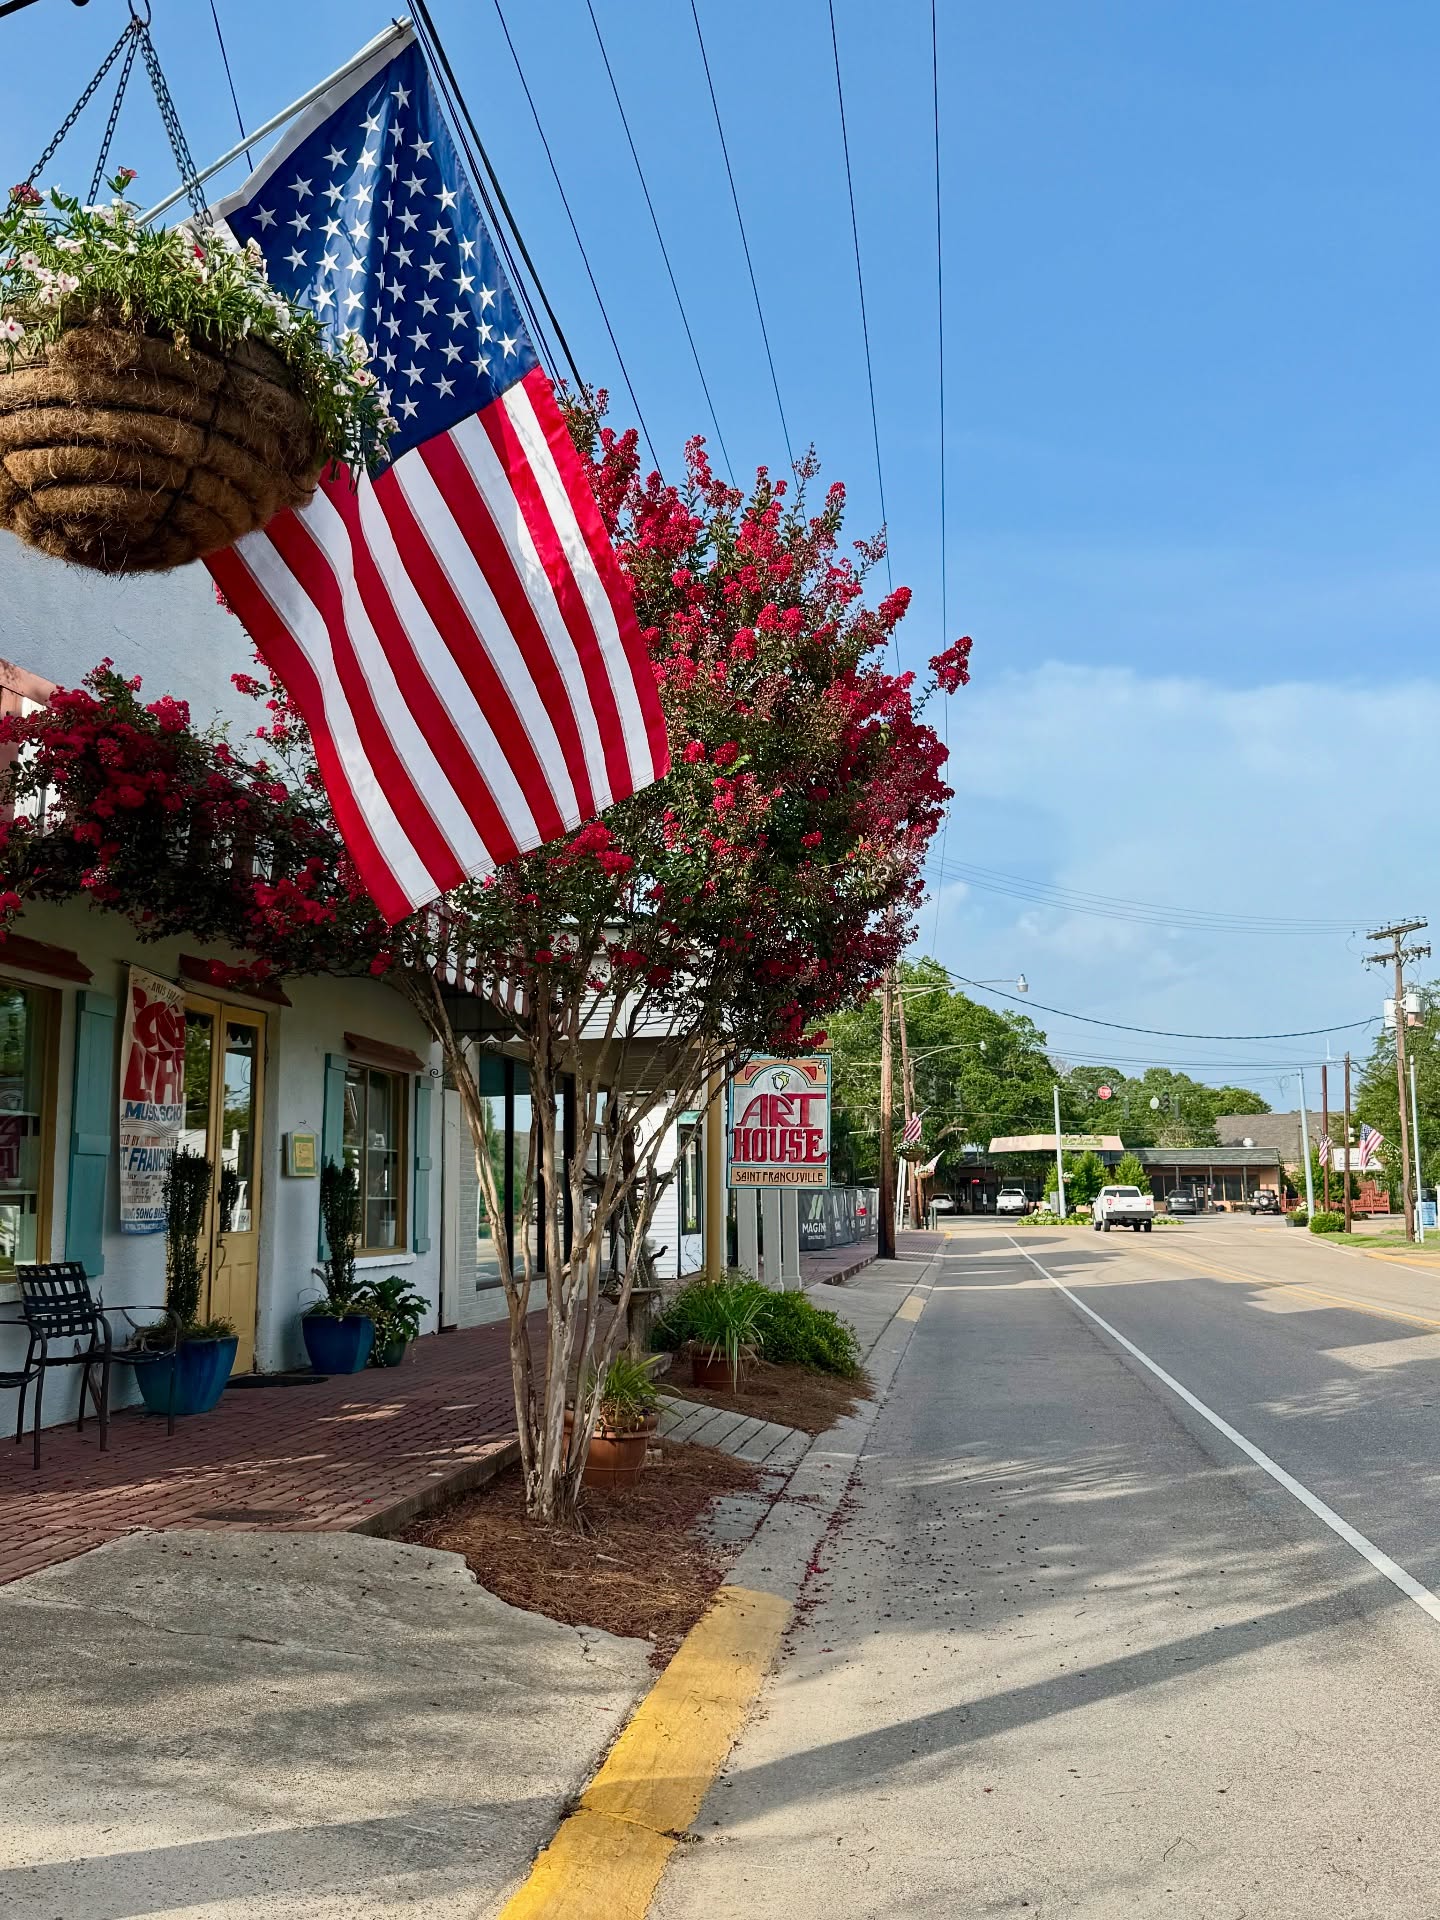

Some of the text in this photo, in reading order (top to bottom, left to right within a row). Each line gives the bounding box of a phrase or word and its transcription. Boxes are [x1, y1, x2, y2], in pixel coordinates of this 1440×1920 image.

[736, 1093, 827, 1127] ART
[729, 1127, 829, 1163] HOUSE
[736, 1171, 823, 1183] SAINT FRANCISVILLE
